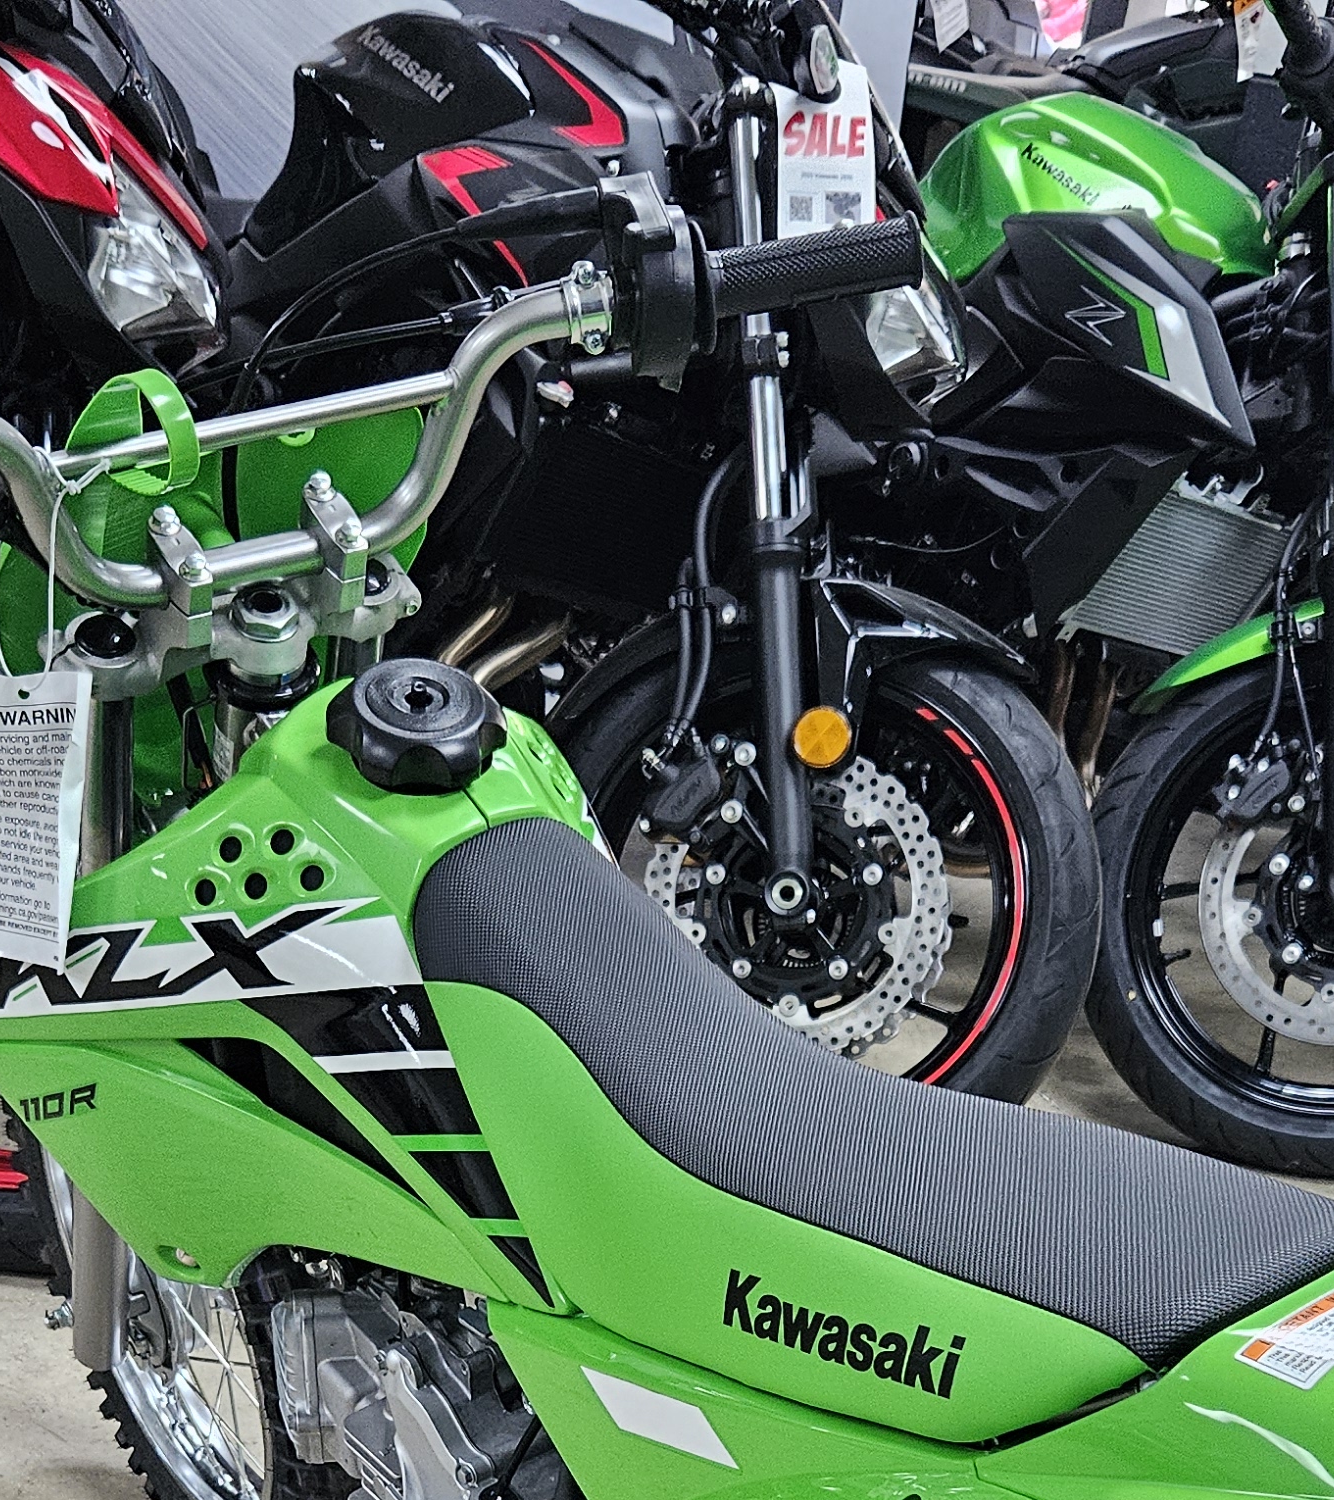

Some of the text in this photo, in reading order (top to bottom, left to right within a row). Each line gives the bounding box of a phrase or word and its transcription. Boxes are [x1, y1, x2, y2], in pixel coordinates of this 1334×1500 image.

[358, 25, 455, 103] Kawasaki
[783, 110, 866, 158] SALE
[1021, 142, 1101, 206] Kawasaki
[0, 707, 76, 726] WARNIN
[32, 732, 49, 742] and
[24, 747, 34, 755] or
[6, 757, 52, 766] chemicals
[19, 768, 62, 778] monoxide
[17, 780, 32, 788] are
[34, 780, 60, 789] known
[2, 789, 12, 798] to
[13, 791, 40, 799] cause
[3, 827, 17, 837] not
[0, 841, 28, 851] service
[13, 853, 29, 863] area
[33, 900, 42, 910] go
[43, 901, 51, 911] to
[7, 921, 33, 933] REMOVED
[723, 1268, 967, 1400] Kawasaki
